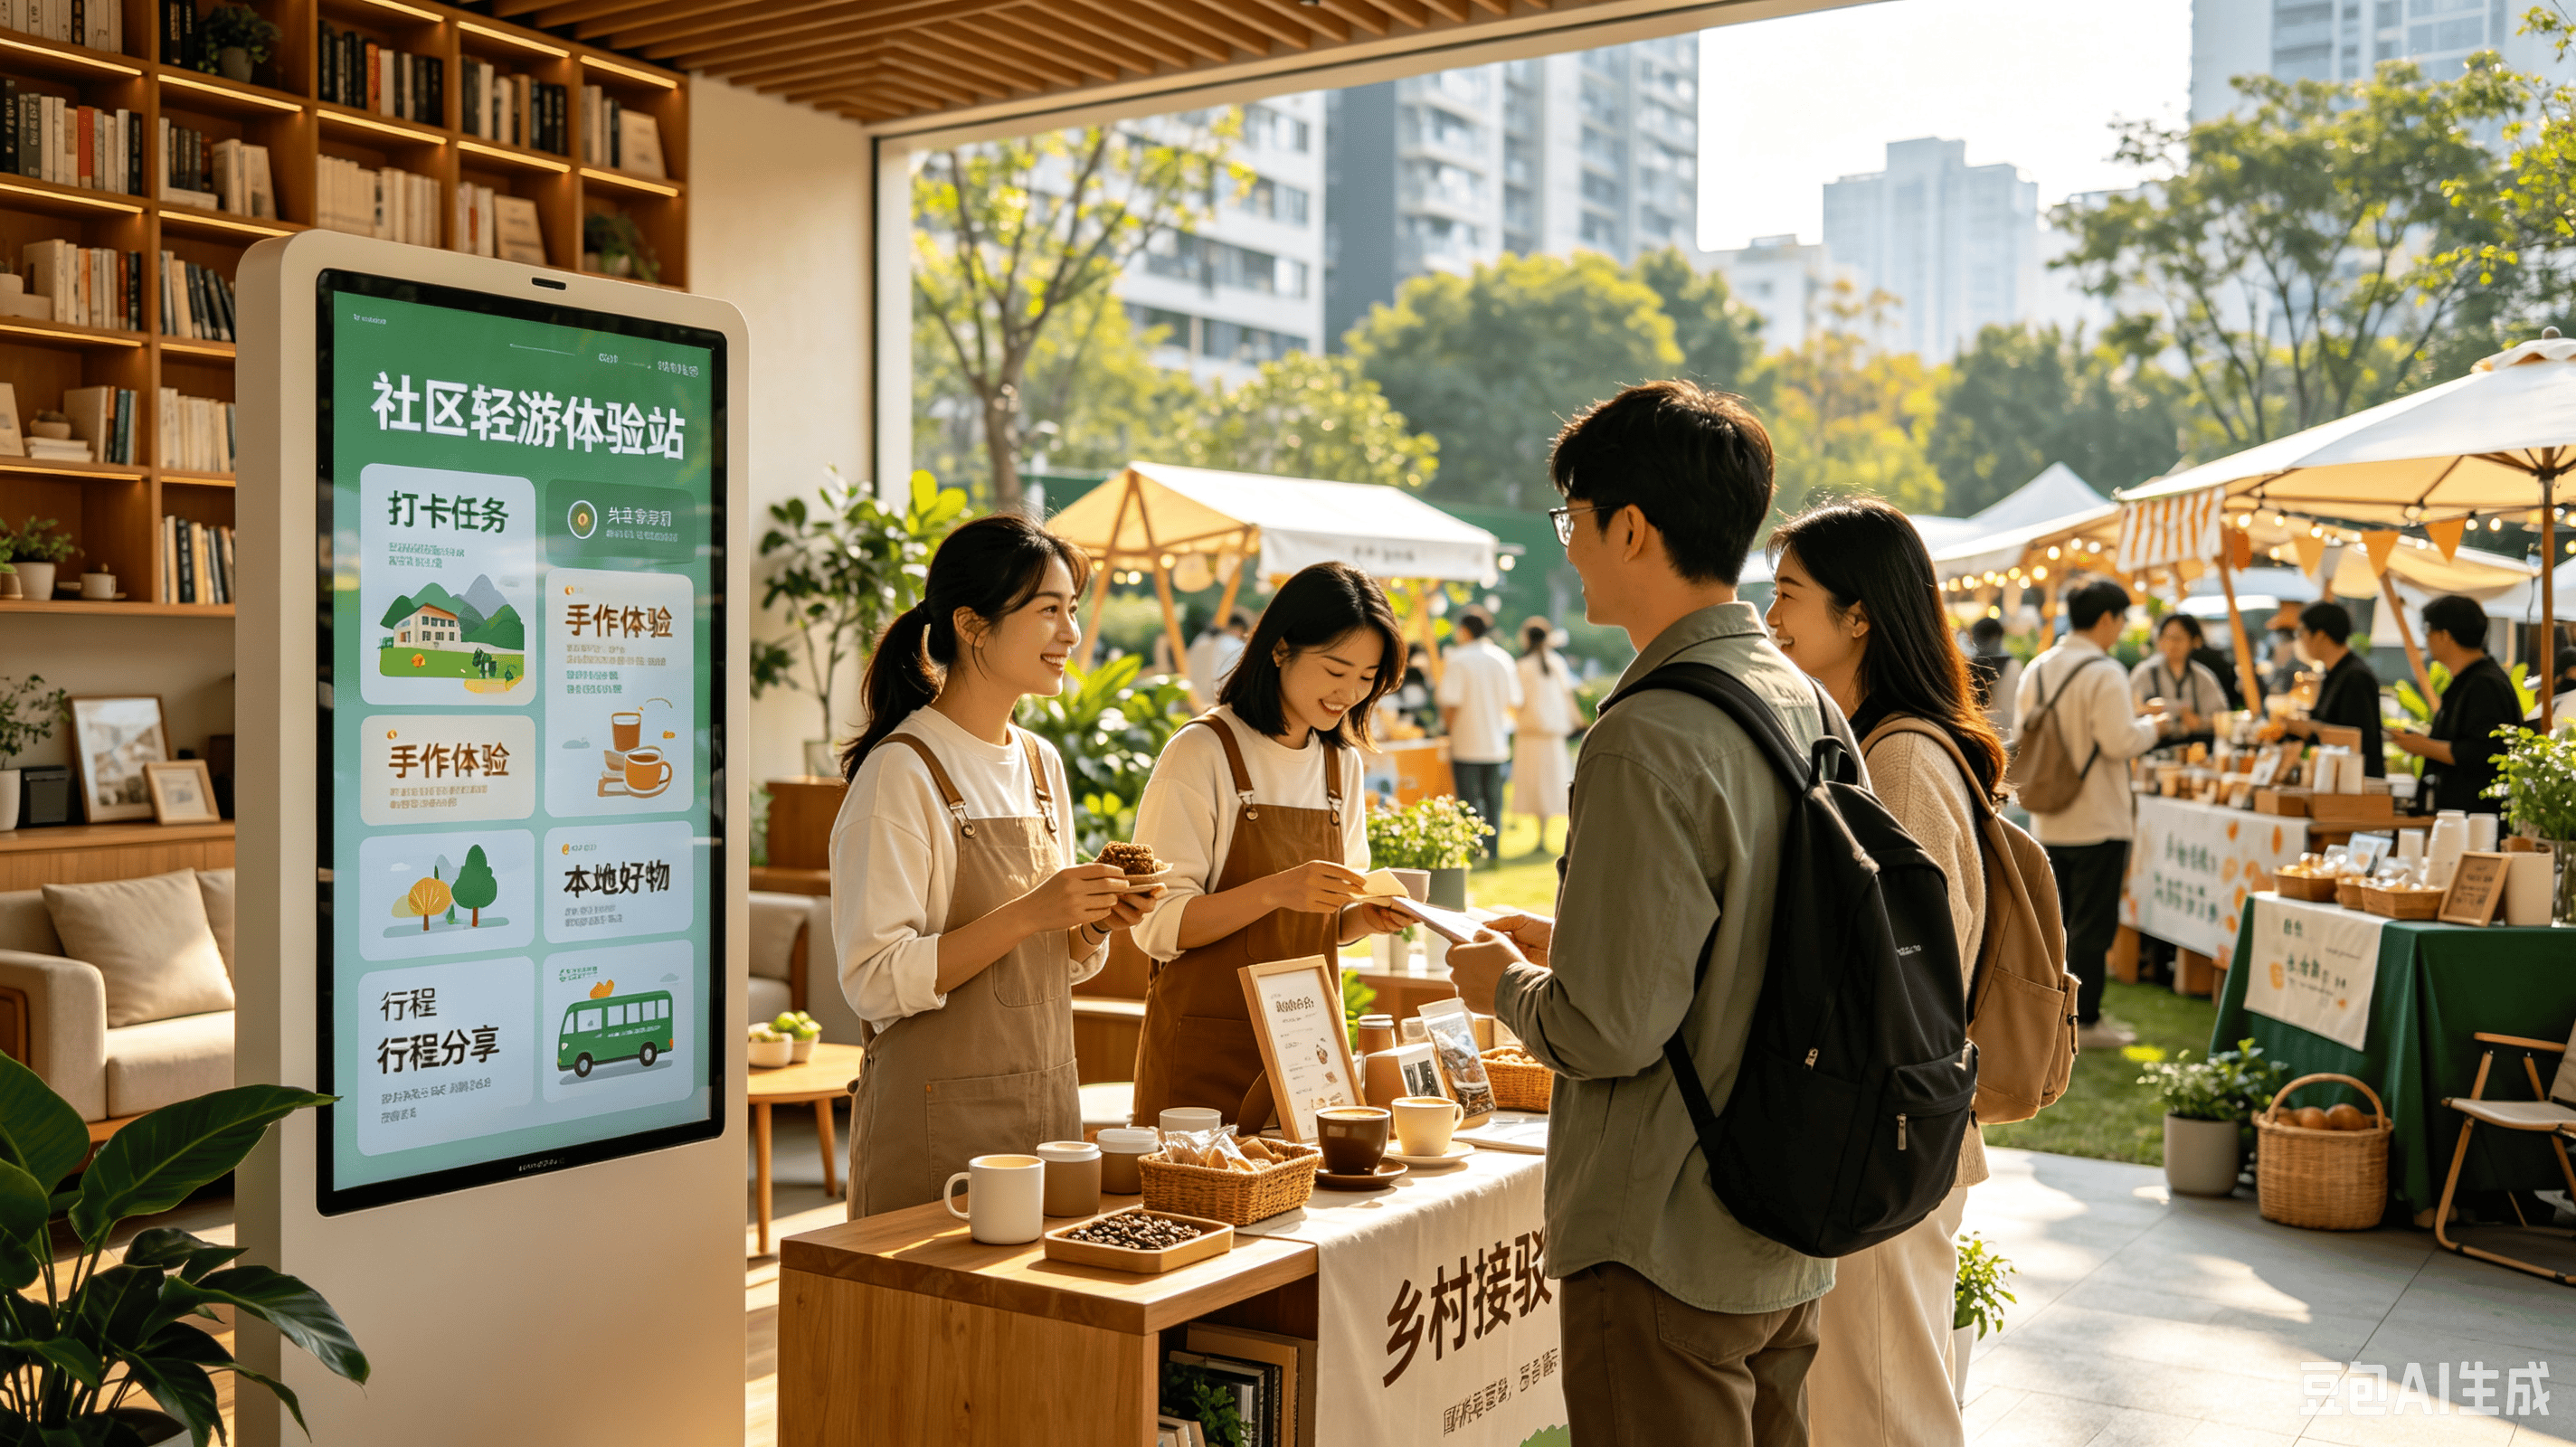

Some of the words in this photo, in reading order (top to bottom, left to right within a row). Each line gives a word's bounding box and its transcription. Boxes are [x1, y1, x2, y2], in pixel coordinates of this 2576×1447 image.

[371, 372, 685, 459] 社区轻游体验站
[387, 491, 509, 534] 打卡任务
[565, 604, 673, 638] 手作体验
[388, 742, 510, 779] 手作体验
[564, 859, 670, 898] 本地好物
[380, 988, 438, 1022] 行程
[377, 1025, 500, 1074] 行程分享
[1382, 1226, 1552, 1388] 乡村接驳
